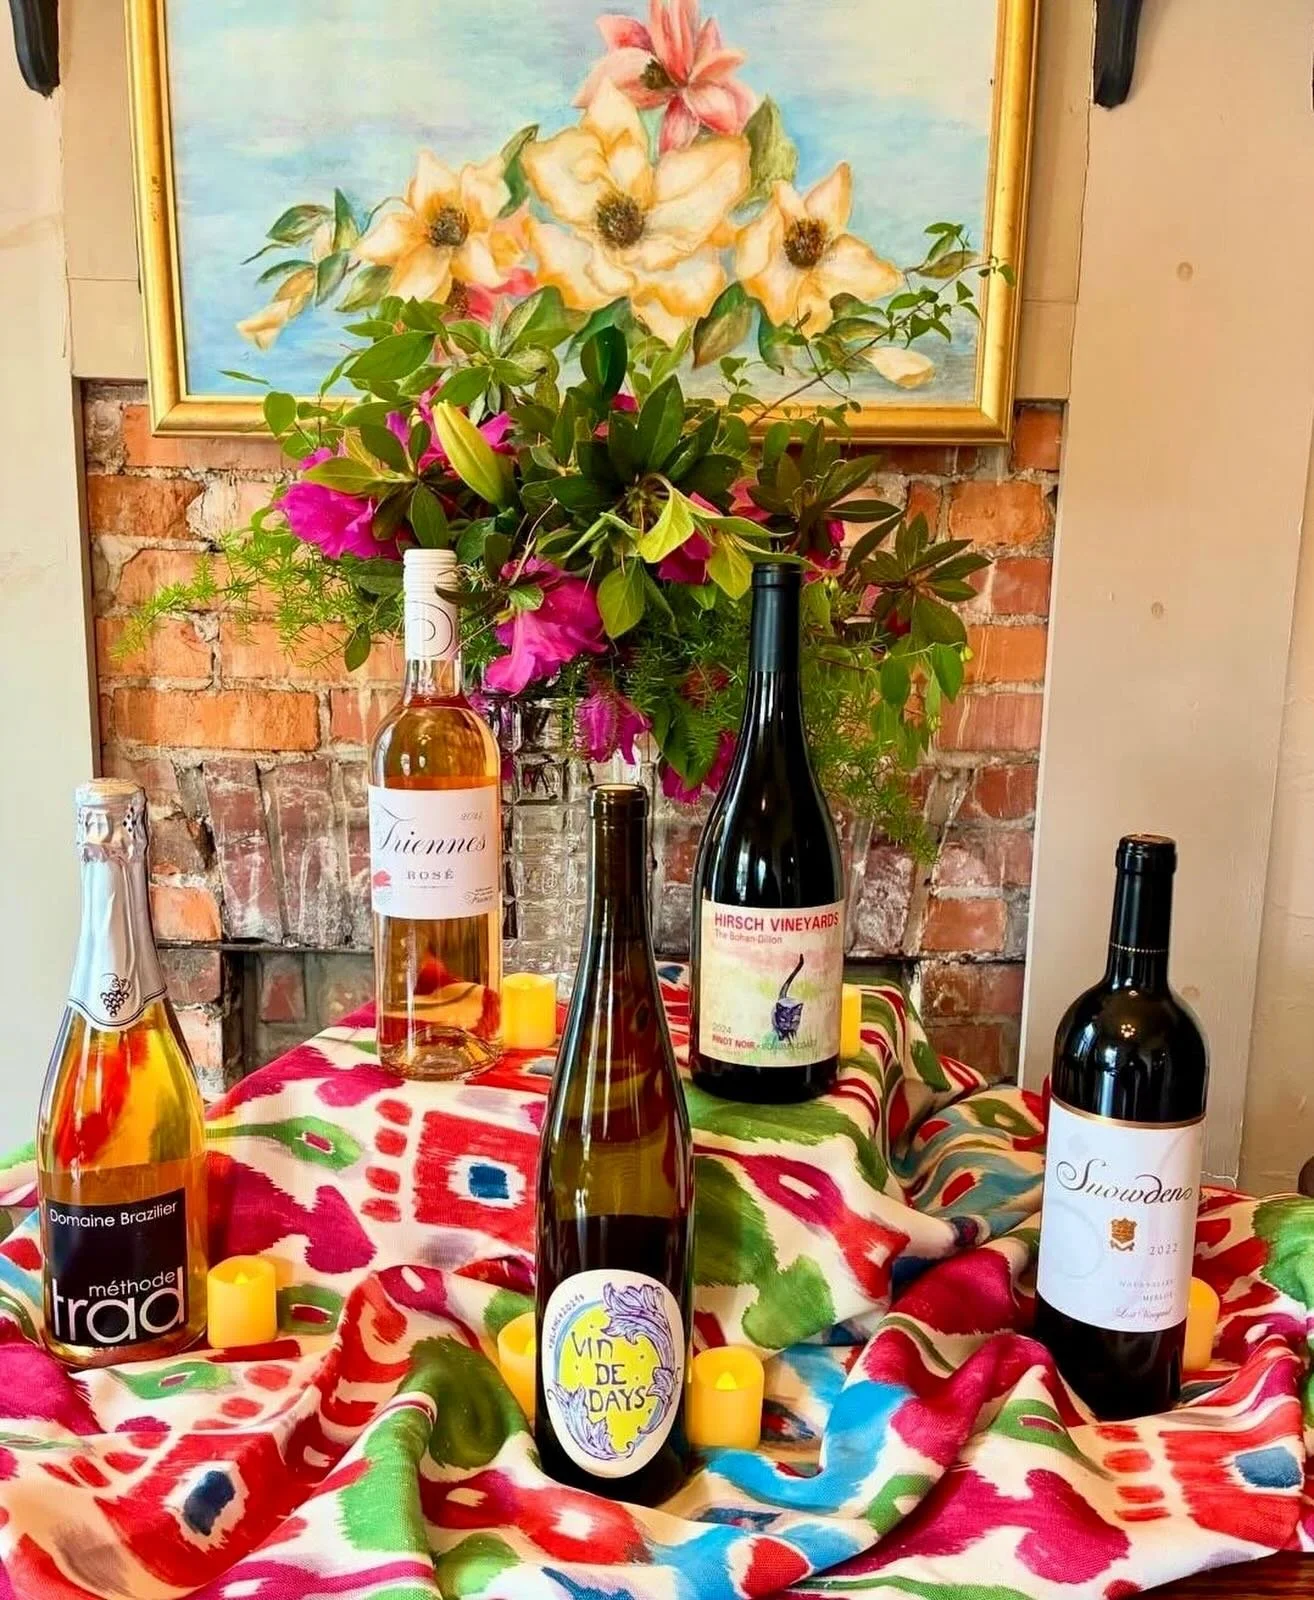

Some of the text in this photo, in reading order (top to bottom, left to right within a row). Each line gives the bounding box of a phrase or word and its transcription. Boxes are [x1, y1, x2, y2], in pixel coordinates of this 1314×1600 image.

[379, 804, 487, 855] Triennes
[407, 868, 455, 880] ROSÉ
[714, 911, 839, 932] HIRSCH VINEYARDS
[714, 928, 783, 945] The Bohan-Dillon
[712, 1033, 733, 1047] PINOT
[735, 1040, 756, 1050] NOIR
[50, 1201, 178, 1228] Domaine Brazilier
[1149, 1242, 1178, 1256] 2022
[88, 1270, 176, 1298] méthode
[51, 1265, 185, 1344] trad
[595, 1363, 627, 1386] DE
[588, 1386, 646, 1413] DAYS
